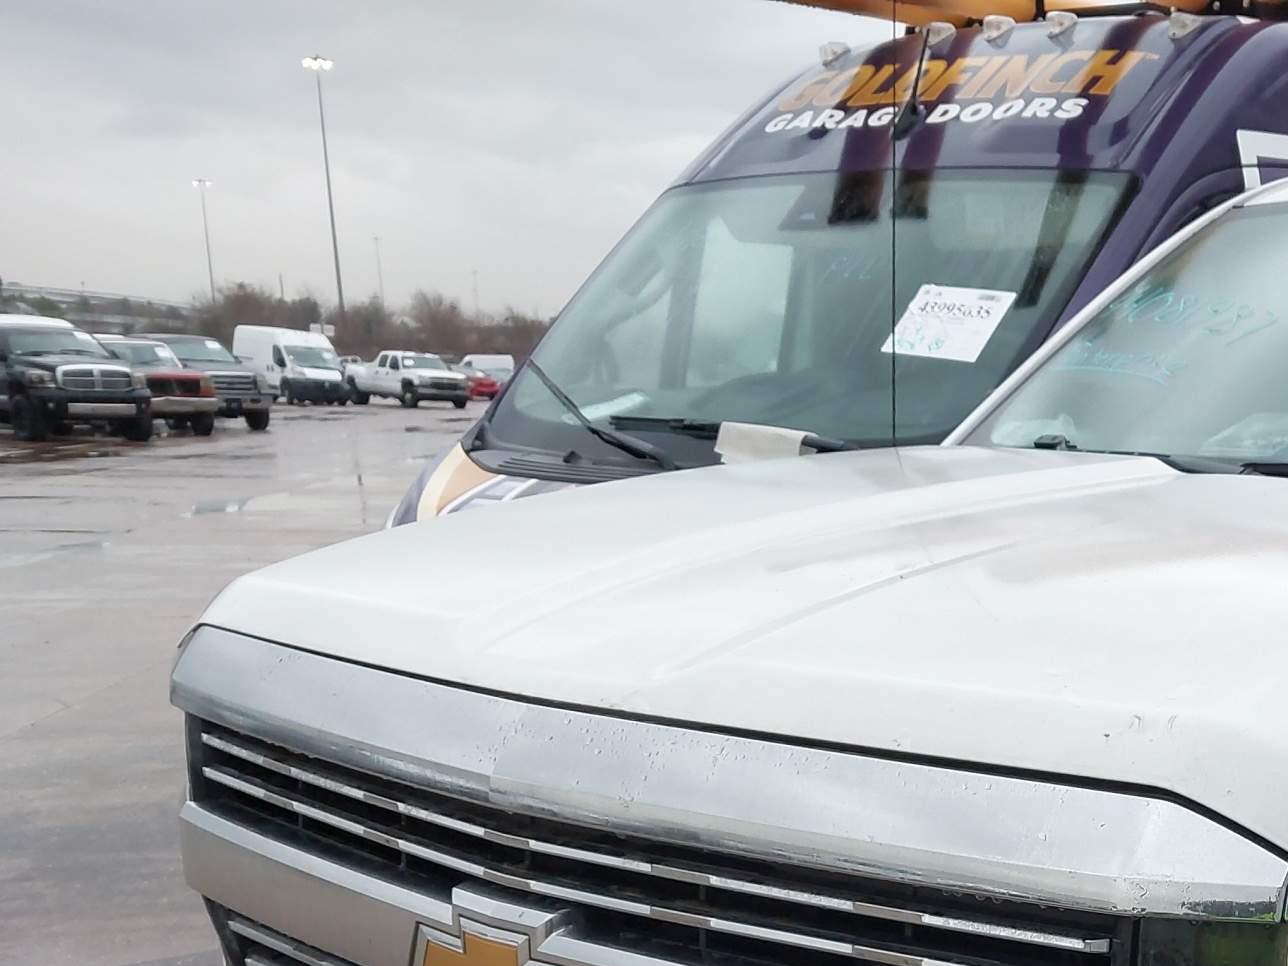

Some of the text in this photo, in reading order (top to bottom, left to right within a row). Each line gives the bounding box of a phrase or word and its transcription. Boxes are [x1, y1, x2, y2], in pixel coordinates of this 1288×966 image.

[778, 49, 1150, 111] GOLDFINCH
[764, 97, 1089, 134] GARAG DOORS
